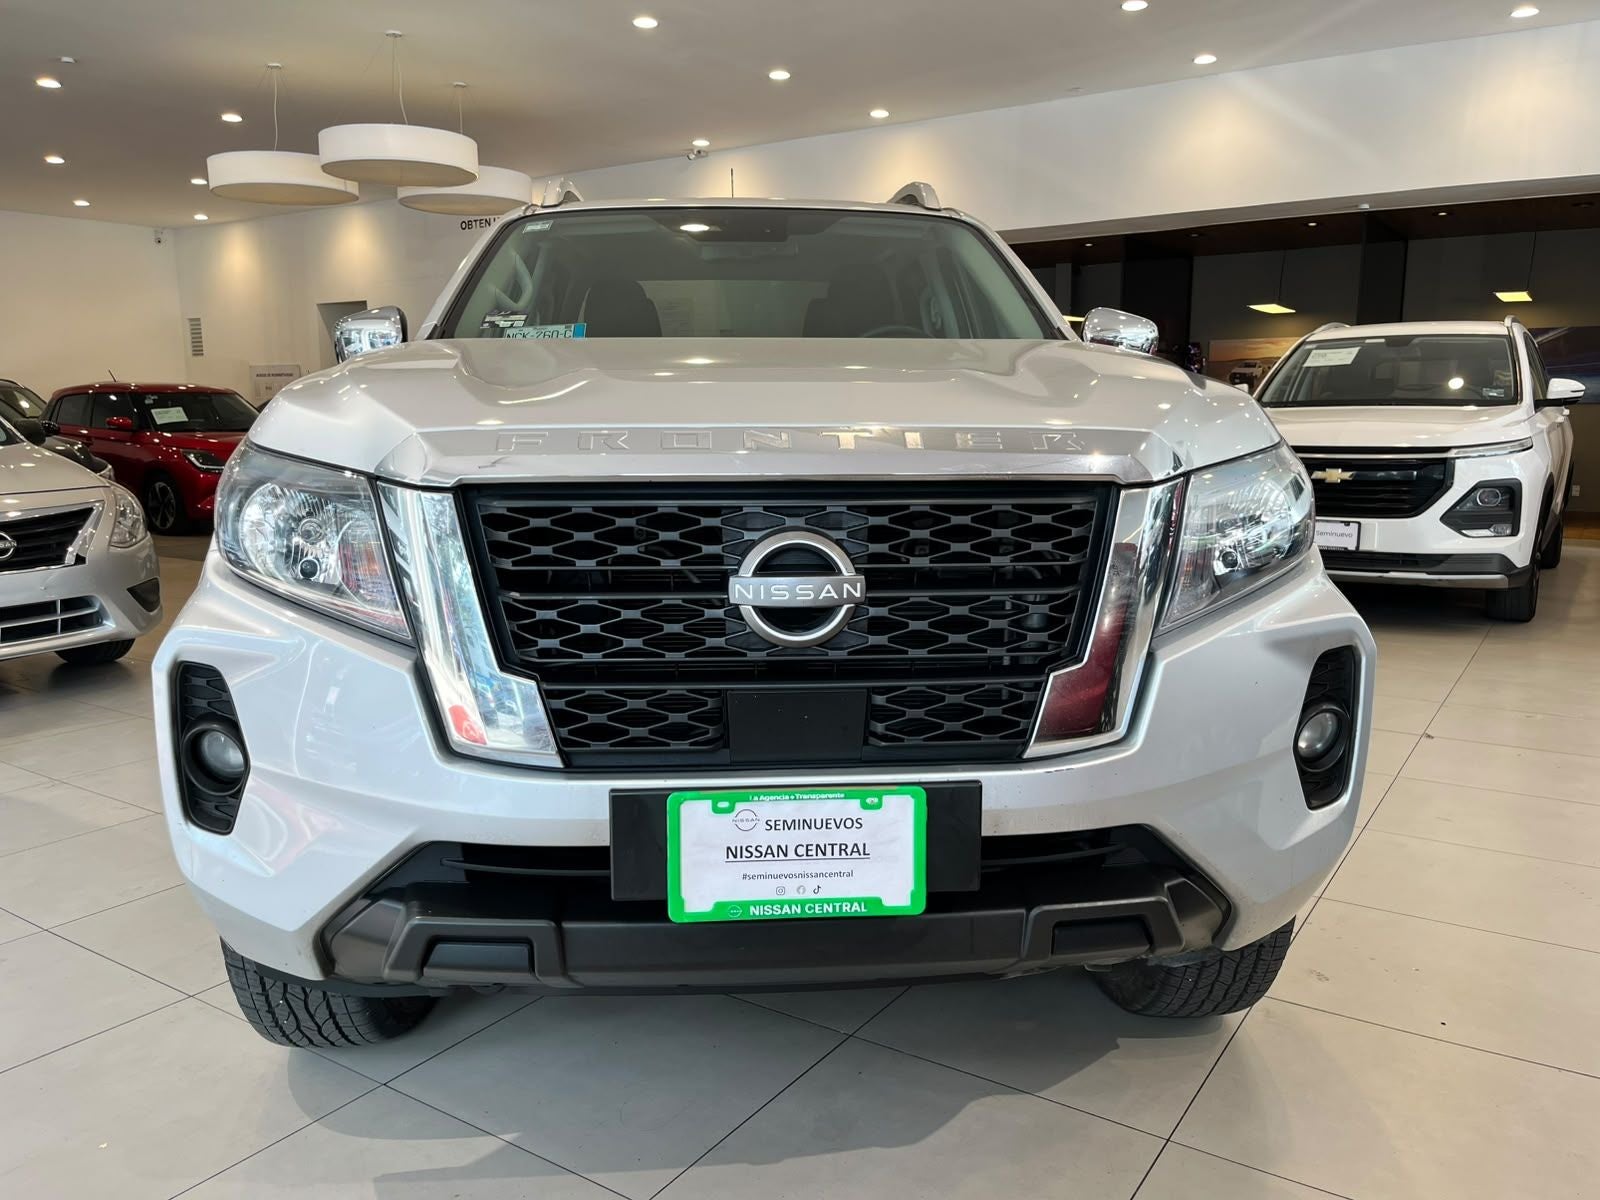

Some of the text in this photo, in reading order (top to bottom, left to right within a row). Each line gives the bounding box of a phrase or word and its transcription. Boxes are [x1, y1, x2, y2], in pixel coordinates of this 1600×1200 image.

[460, 217, 491, 230] OBTEN
[496, 431, 1084, 450] FRONTIER
[734, 582, 861, 600] NISSAN
[795, 793, 845, 801] Transparente
[765, 817, 863, 831] SEMINUEVOS
[725, 842, 870, 859] NISSAN CENTRAL
[742, 869, 854, 880] #seminuevosnissancentral
[749, 904, 801, 916] NISSAN
[805, 901, 868, 913] CENTRAL
